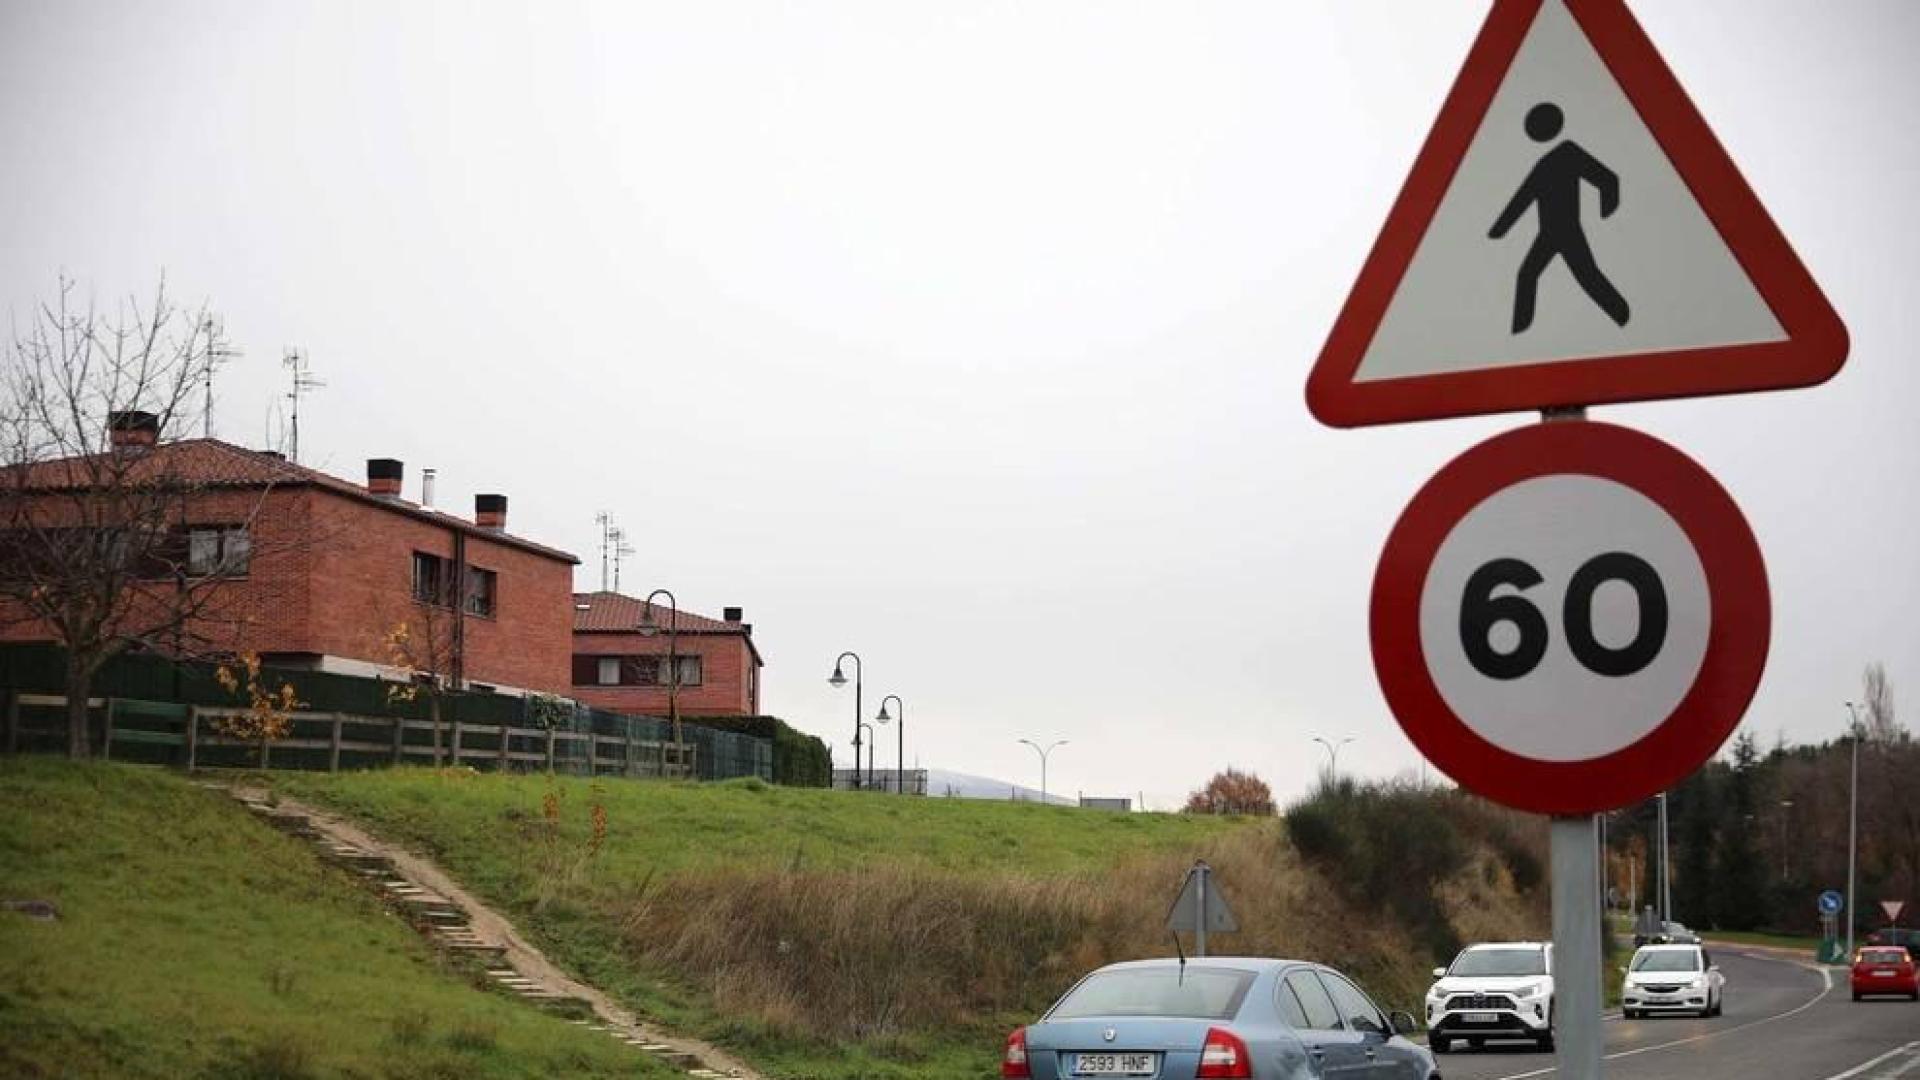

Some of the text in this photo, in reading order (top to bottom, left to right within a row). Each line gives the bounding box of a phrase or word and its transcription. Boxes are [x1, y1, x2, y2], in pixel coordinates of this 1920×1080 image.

[1459, 551, 1669, 680] 60
[1080, 1056, 1149, 1071] 2593 HNF
